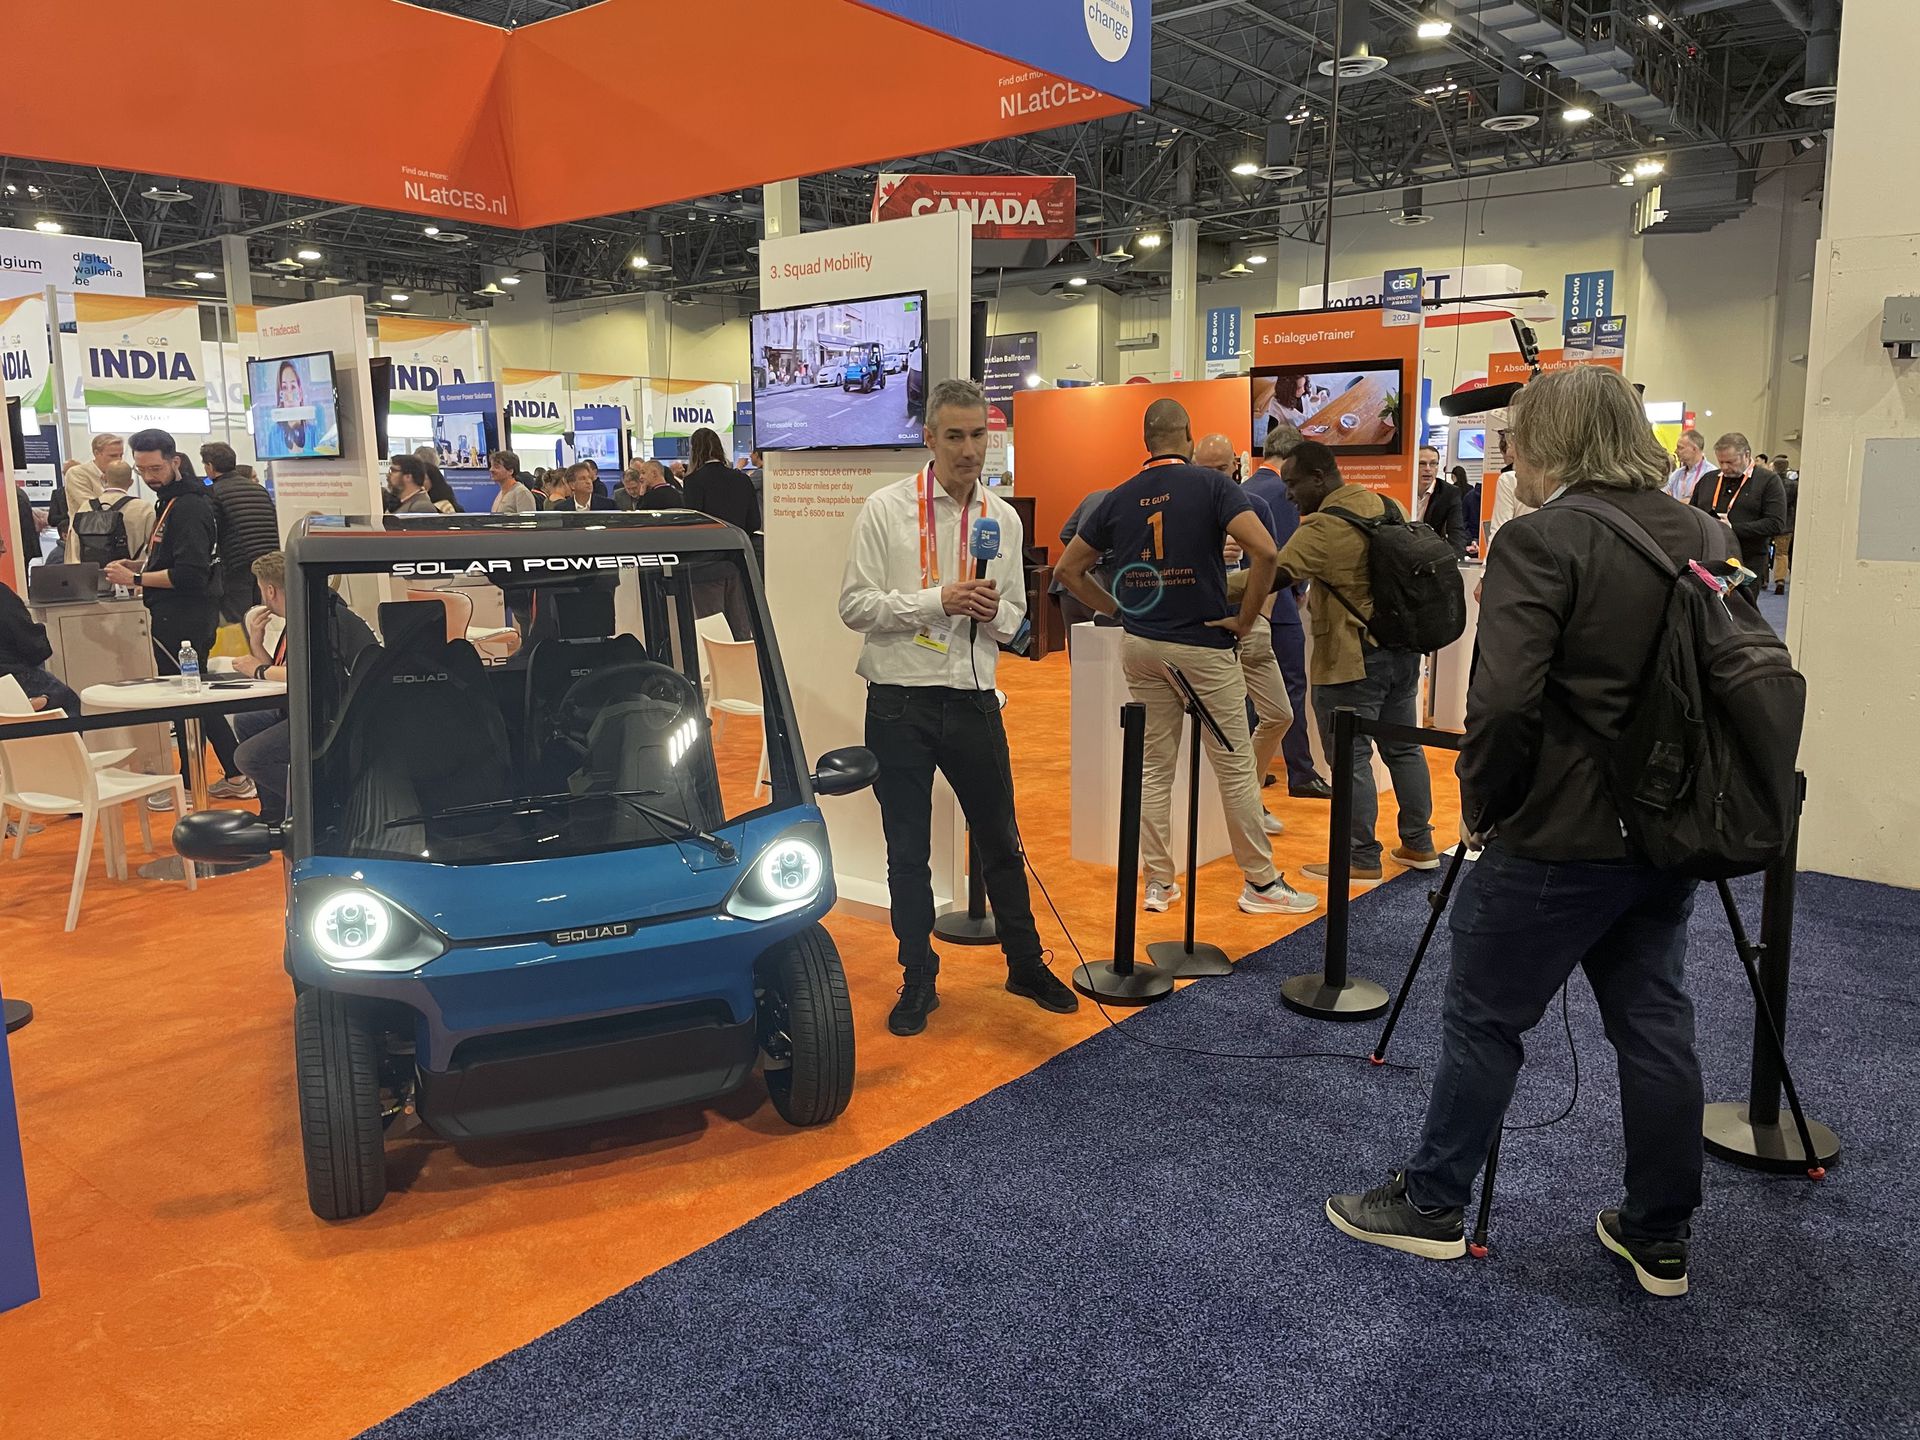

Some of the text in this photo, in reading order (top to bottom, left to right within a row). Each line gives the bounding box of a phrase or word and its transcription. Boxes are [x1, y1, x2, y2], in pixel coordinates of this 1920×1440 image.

[1120, 5, 1129, 18] the
[1088, 3, 1128, 41] change
[999, 75, 1014, 87] Find
[1015, 73, 1028, 84] out
[401, 165, 417, 176] Find
[417, 170, 429, 178] out
[404, 180, 508, 216] NLatCES.nl
[72, 252, 112, 265] digital
[74, 265, 123, 278] wallonia
[770, 251, 873, 281] 3. Squad Mobility
[1392, 279, 1412, 290] CES
[1570, 277, 1581, 320] 5560
[270, 323, 302, 337] Tradecast
[1571, 326, 1587, 334] CES
[1601, 323, 1619, 332] CES
[1262, 328, 1356, 345] 5. DialogueTrainer
[88, 347, 197, 381] INDIA
[1004, 353, 1030, 362] Ballroom
[1494, 365, 1501, 373] 7.
[1542, 360, 1567, 370] Audio
[507, 399, 560, 419] INDIA
[672, 406, 715, 424] INDIA
[772, 467, 872, 477] WORLD'S FIRST SOLAR CITY CAR
[772, 481, 853, 492] Up to 20 Solar miles per day
[816, 495, 850, 506] Swappable
[1140, 492, 1170, 507] EZ GUYS
[773, 508, 797, 519] Starting
[804, 506, 809, 517] $
[391, 553, 680, 576] SOLAR POWERED
[392, 673, 448, 684] SQUAD
[570, 668, 592, 677] SQ
[556, 924, 628, 943] SQUAD
